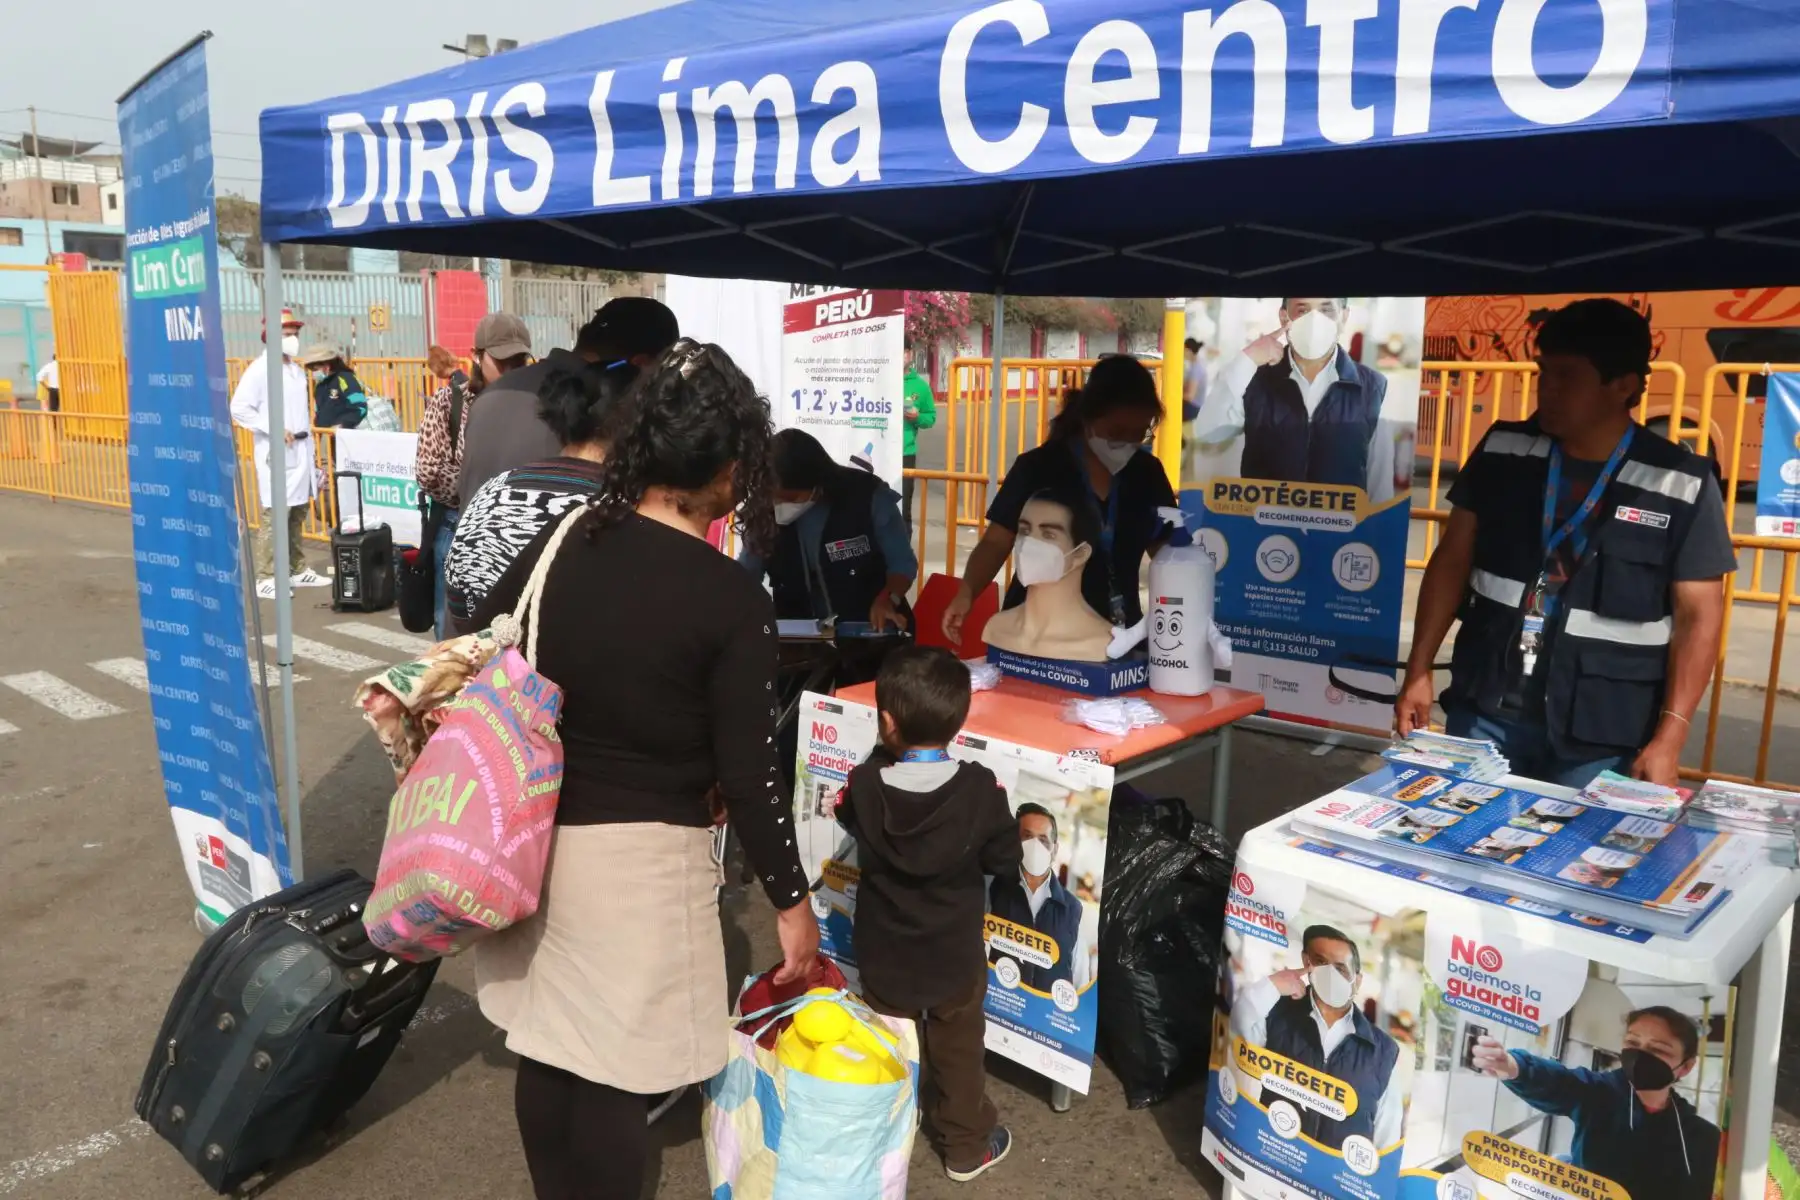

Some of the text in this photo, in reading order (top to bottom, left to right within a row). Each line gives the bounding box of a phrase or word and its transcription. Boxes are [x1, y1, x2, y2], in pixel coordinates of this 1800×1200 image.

[327, 0, 1647, 228] DIRIS Lima Centro
[815, 289, 873, 326] PERÚ
[811, 322, 887, 344] COMPLETA TUS DOSIS
[829, 396, 892, 415] y dosis
[376, 461, 385, 470] de
[387, 462, 407, 475] Redes
[365, 477, 401, 505] Lima
[1214, 482, 1357, 511] PROTÉGETE
[1259, 512, 1352, 526] RECOMENDACIONES:
[1260, 586, 1295, 595] mascarilla
[156, 620, 189, 636] CENTRO
[1233, 624, 1251, 634] más
[1254, 627, 1309, 643] información
[1309, 635, 1336, 647] llama
[1252, 639, 1260, 648] al
[1270, 643, 1286, 653] 113
[1287, 645, 1319, 657] SALUD
[1000, 661, 1089, 687] Protégete de la COVID-19
[1150, 655, 1189, 669] ALCOHOL
[165, 686, 199, 703] CENTRO
[812, 720, 837, 744] NO
[809, 739, 857, 760] bajemos la
[508, 746, 528, 782] DUBA
[428, 832, 468, 855] DUBAI
[502, 827, 534, 859] DUBAI
[1273, 905, 1284, 920] la
[1451, 934, 1503, 972] NO
[1448, 959, 1541, 1001] bajemos la
[1446, 978, 1540, 1021] guardia
[1456, 998, 1491, 1016] COVID-19
[1492, 1012, 1501, 1020] no
[1503, 1015, 1512, 1024] se
[1514, 1019, 1524, 1028] ha
[1526, 1022, 1538, 1033] ido
[1239, 1044, 1347, 1104] PROTÉGETE
[1265, 1077, 1343, 1117] RECOMENDACIONES:
[1243, 1152, 1275, 1175] información
[1465, 1141, 1613, 1200] TRANSPORTE PÚBLI
[1483, 1135, 1609, 1193] PROTÉGETE EN EL
